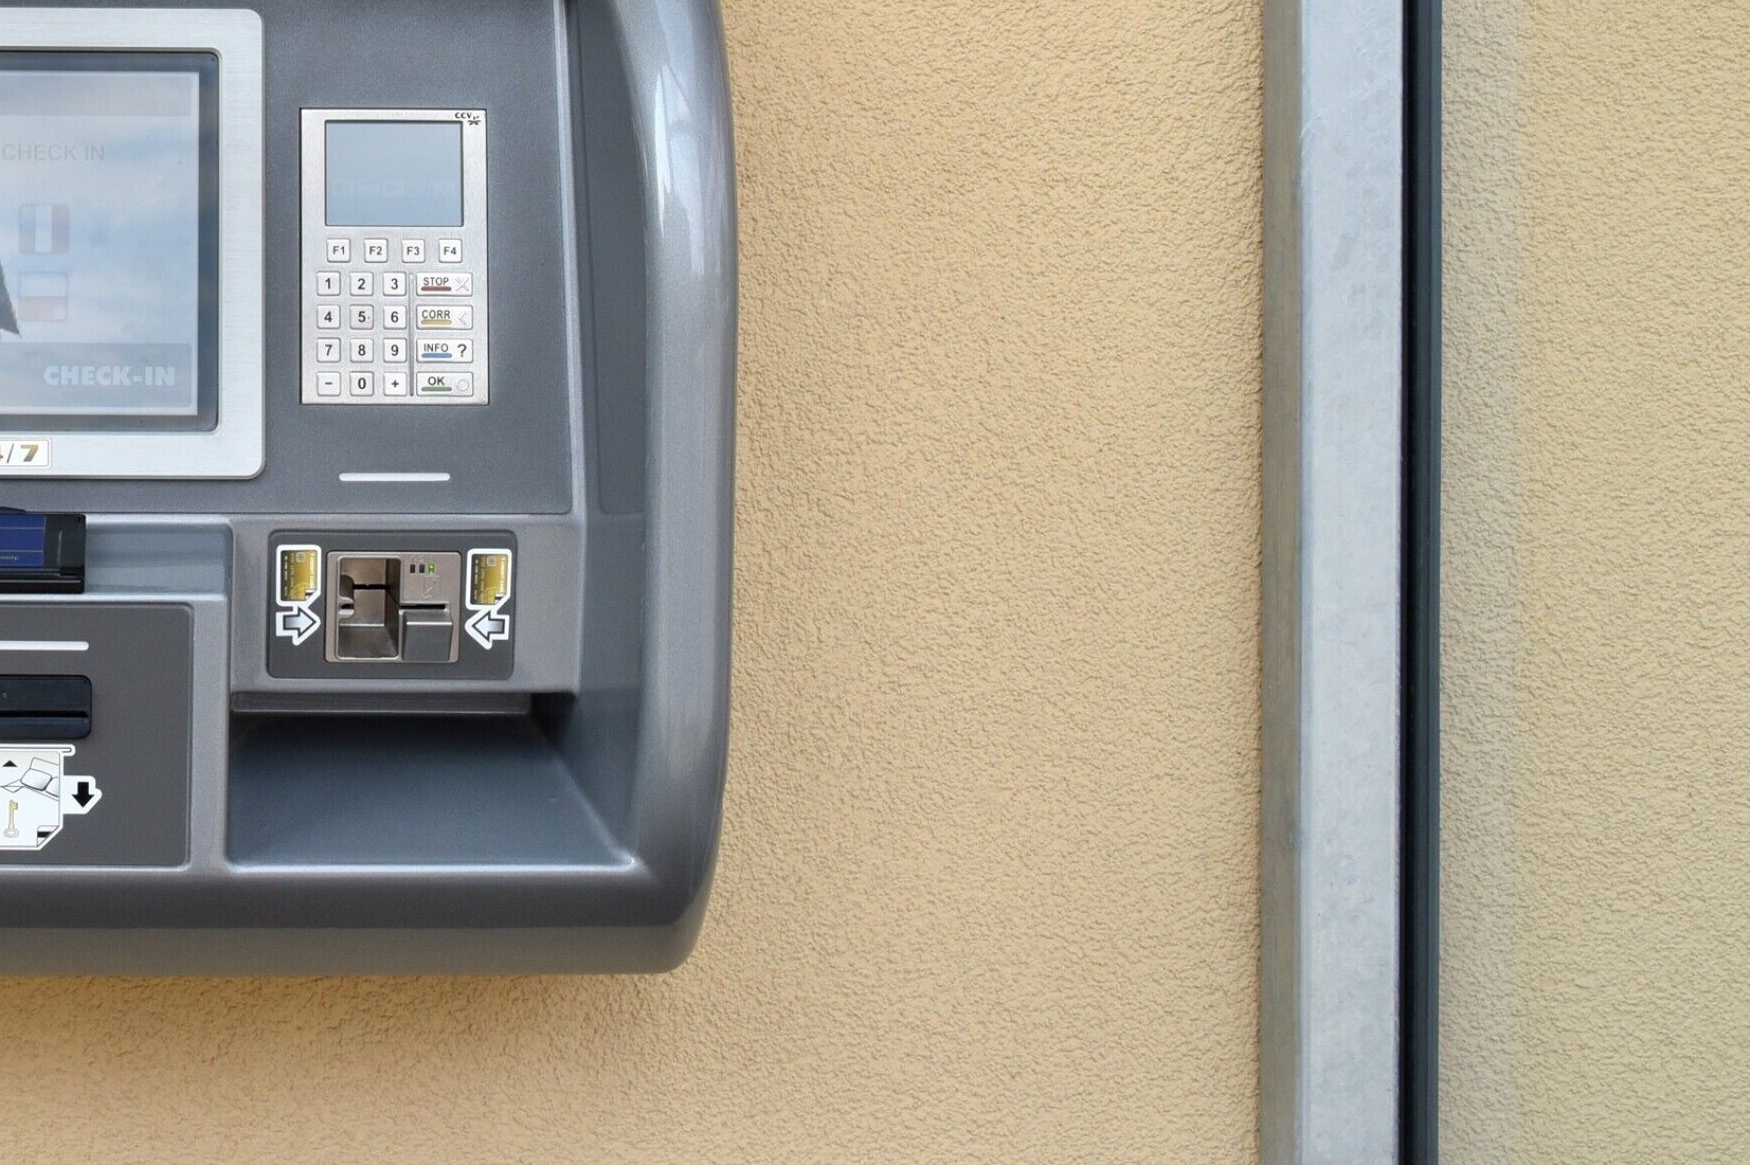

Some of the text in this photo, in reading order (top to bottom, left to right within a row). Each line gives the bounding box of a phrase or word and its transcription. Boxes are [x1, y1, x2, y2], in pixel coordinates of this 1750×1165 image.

[454, 111, 472, 120] CCV
[1, 143, 78, 162] CHECK
[84, 143, 105, 162] IN
[332, 246, 457, 256] F1 F2 F3 F4
[324, 278, 399, 290] 1 2 3
[423, 276, 449, 286] STOP
[323, 311, 399, 323] 4 5 6
[421, 309, 451, 320] CORR
[324, 344, 399, 356] 7 8 9
[423, 343, 449, 353] INFO
[43, 364, 176, 386] CHECK-IN
[357, 378, 366, 390] 0
[427, 376, 445, 387] OK
